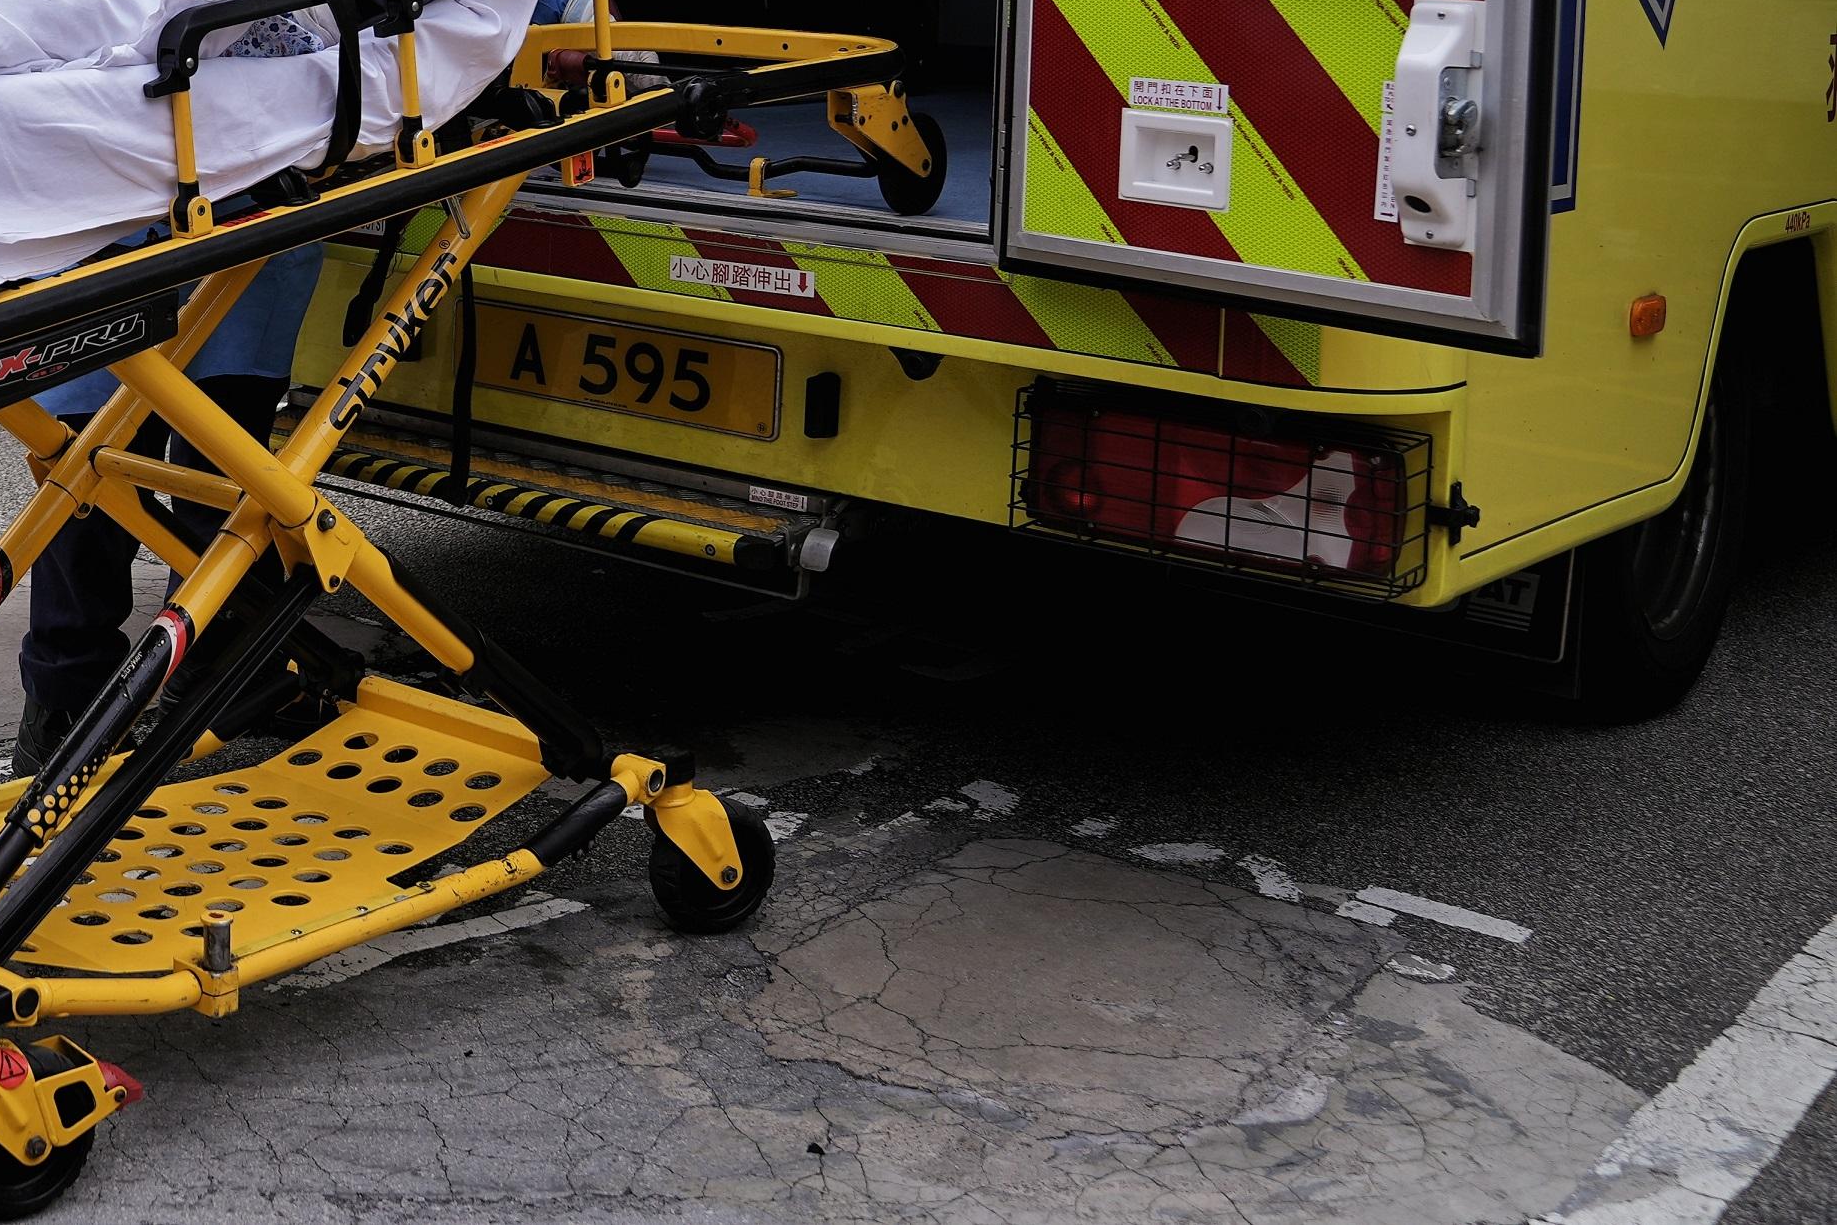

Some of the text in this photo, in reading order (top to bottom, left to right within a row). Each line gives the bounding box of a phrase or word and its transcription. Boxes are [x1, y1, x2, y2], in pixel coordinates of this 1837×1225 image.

[1133, 95, 1212, 111] LOCK AT THE BOTTOM
[672, 257, 791, 294] 小心腳踏伸出
[329, 252, 458, 431] stryker
[510, 323, 711, 412] A 595
[763, 496, 772, 504] THE
[773, 498, 786, 507] FOOT
[787, 501, 799, 509] STEP
